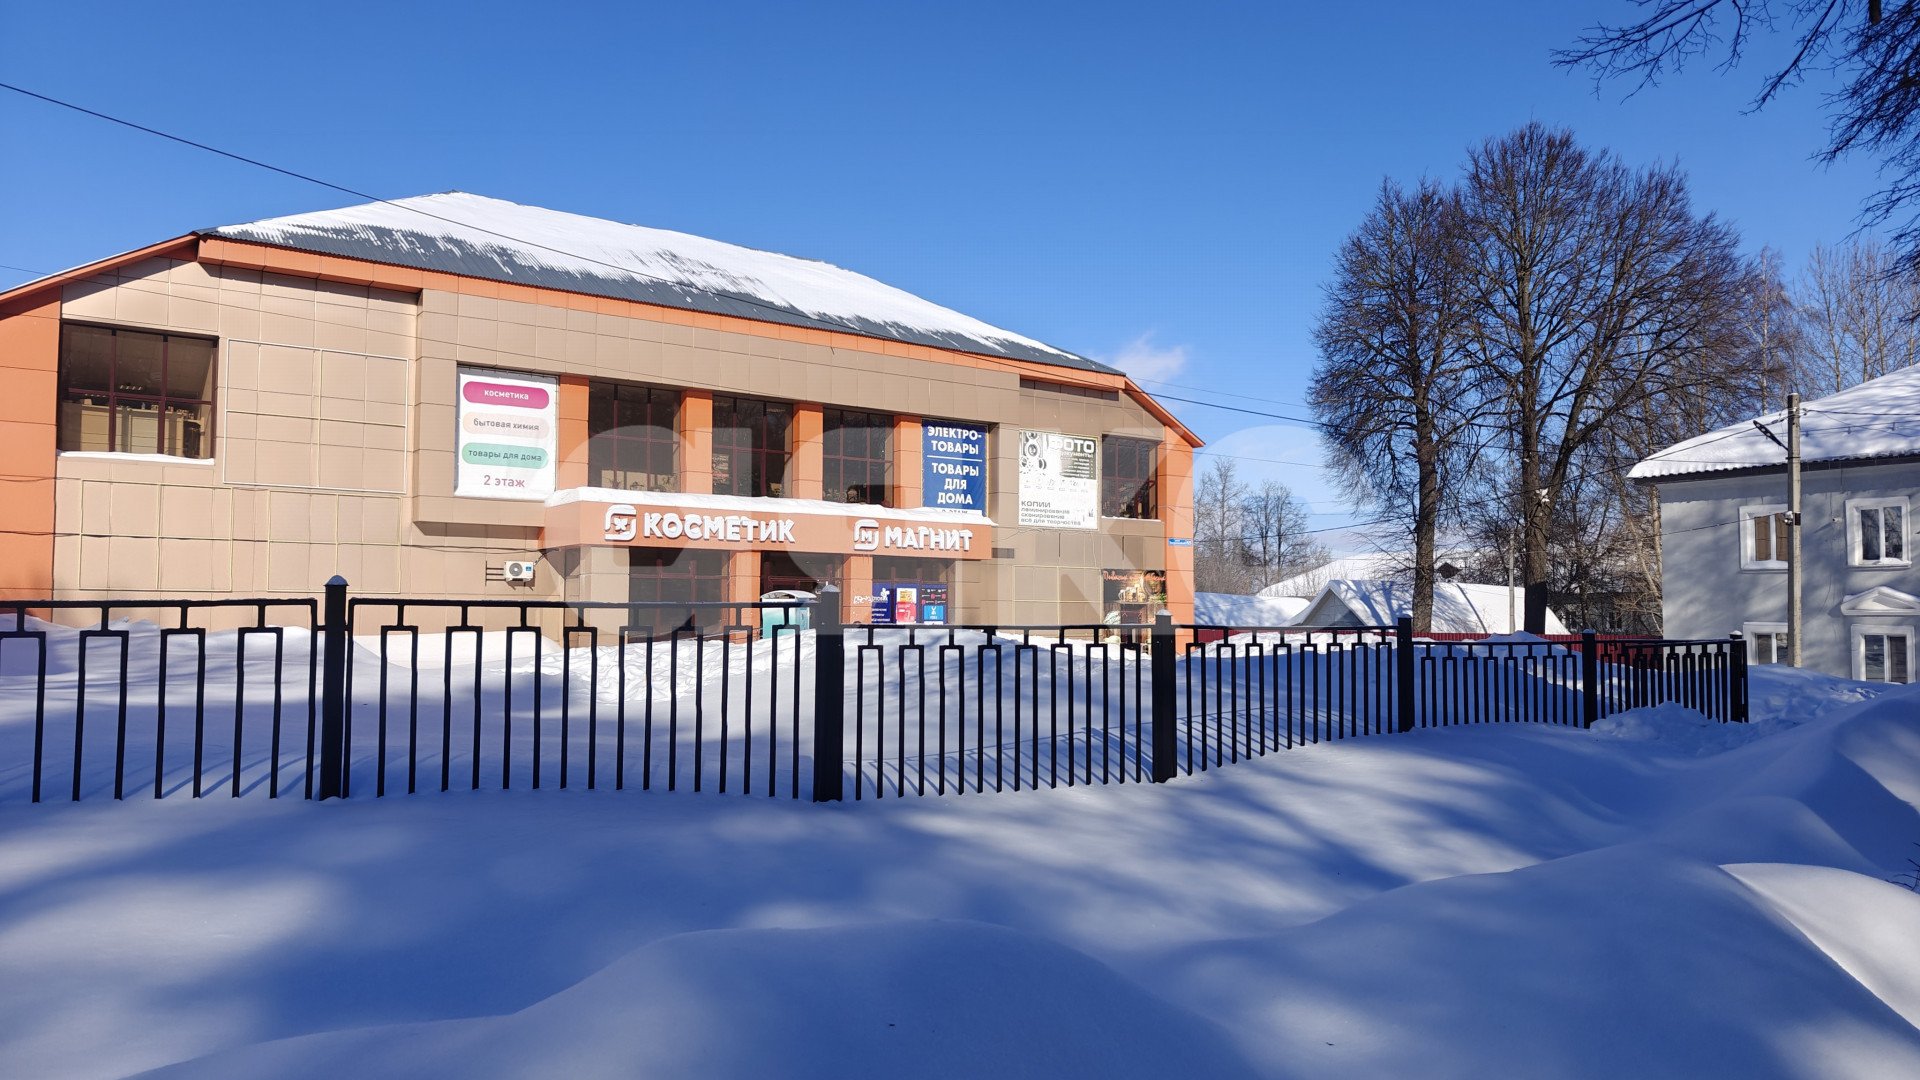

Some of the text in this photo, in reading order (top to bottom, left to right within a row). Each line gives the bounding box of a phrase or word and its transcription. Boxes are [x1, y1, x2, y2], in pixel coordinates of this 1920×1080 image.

[484, 389, 529, 400] косметика
[473, 418, 540, 431] бытовая химия
[927, 426, 982, 441] ЭЛЕКТРО-
[931, 440, 979, 455] ТОВАРЫ
[469, 449, 542, 462] товары для дома
[931, 462, 979, 477] ТОВАРЫ
[483, 474, 525, 488] 2 этаж
[944, 478, 967, 490] ДЛЯ
[937, 492, 973, 505] ДОМА
[1021, 500, 1051, 508] КОПИИ
[643, 512, 796, 543] КОСМЕТИК
[884, 525, 974, 552] МАГНИТ
